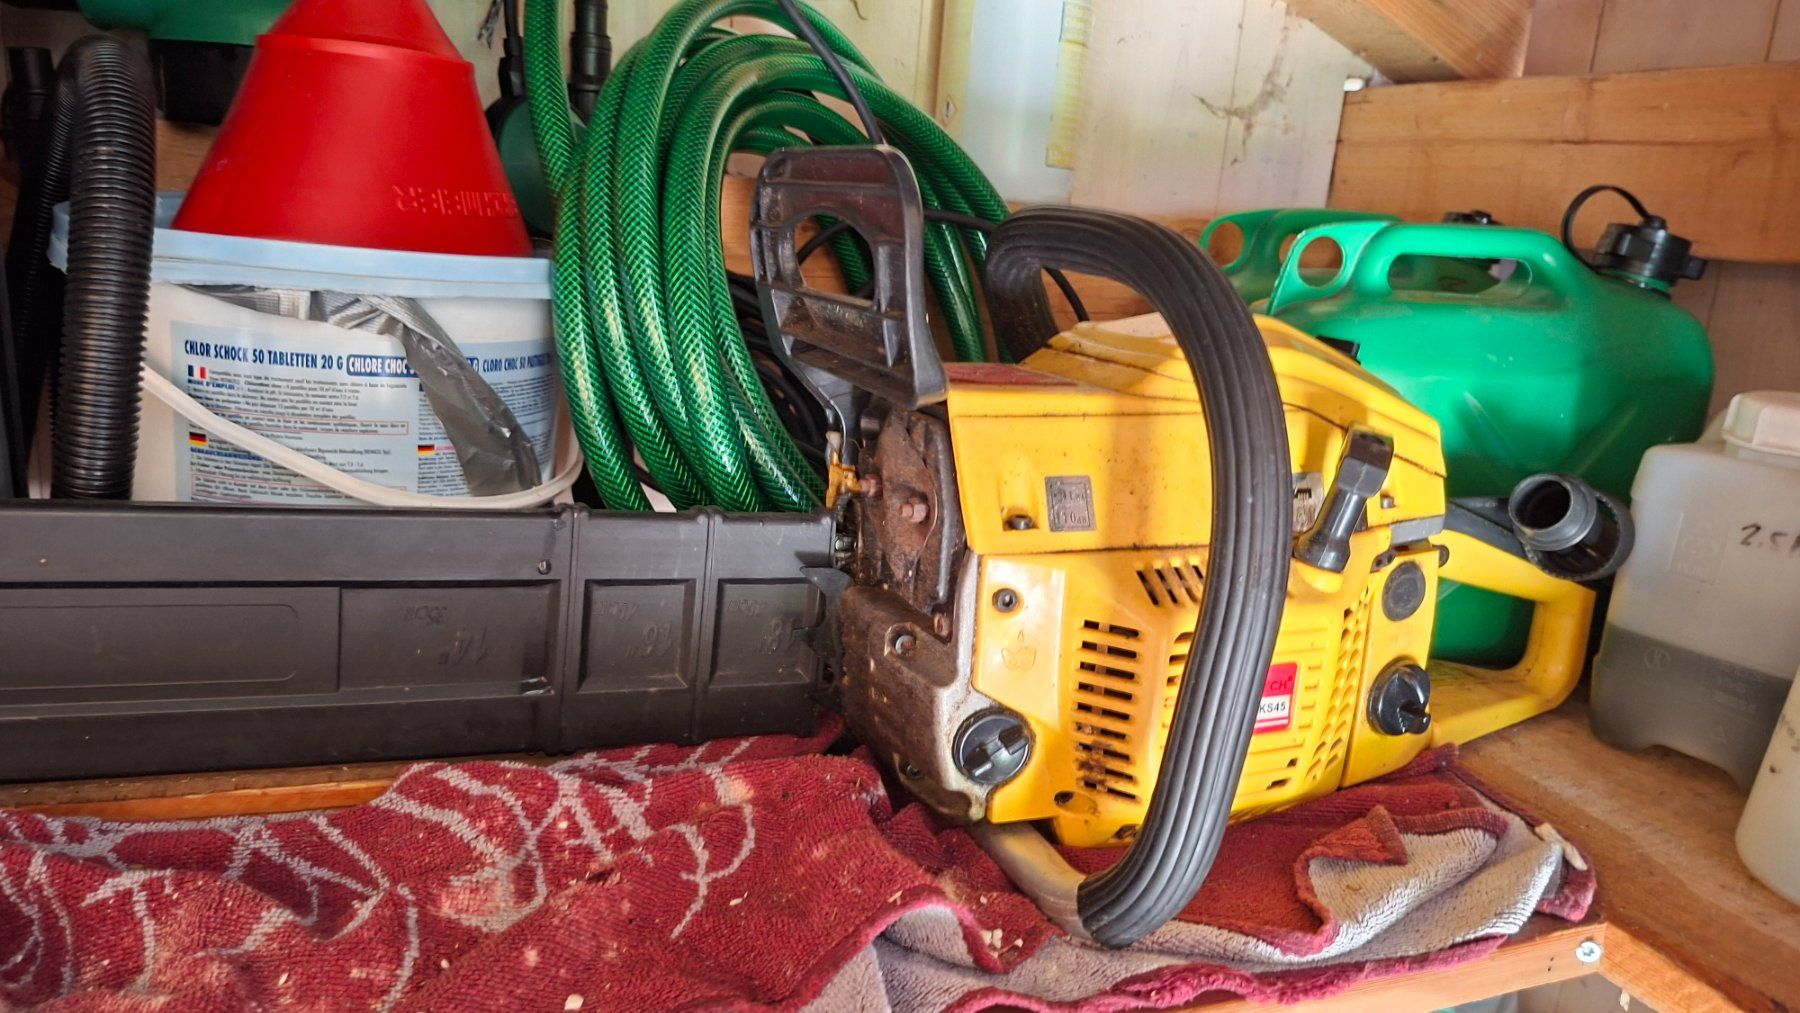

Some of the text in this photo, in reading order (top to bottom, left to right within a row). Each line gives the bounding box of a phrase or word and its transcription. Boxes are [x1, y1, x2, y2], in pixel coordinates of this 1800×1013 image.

[185, 340, 344, 370] CHLOR SCHOCK 50 TABLETTEN 20 G
[349, 357, 383, 374] CHLORE
[385, 358, 408, 374] CHOC
[483, 358, 503, 373] CLORO
